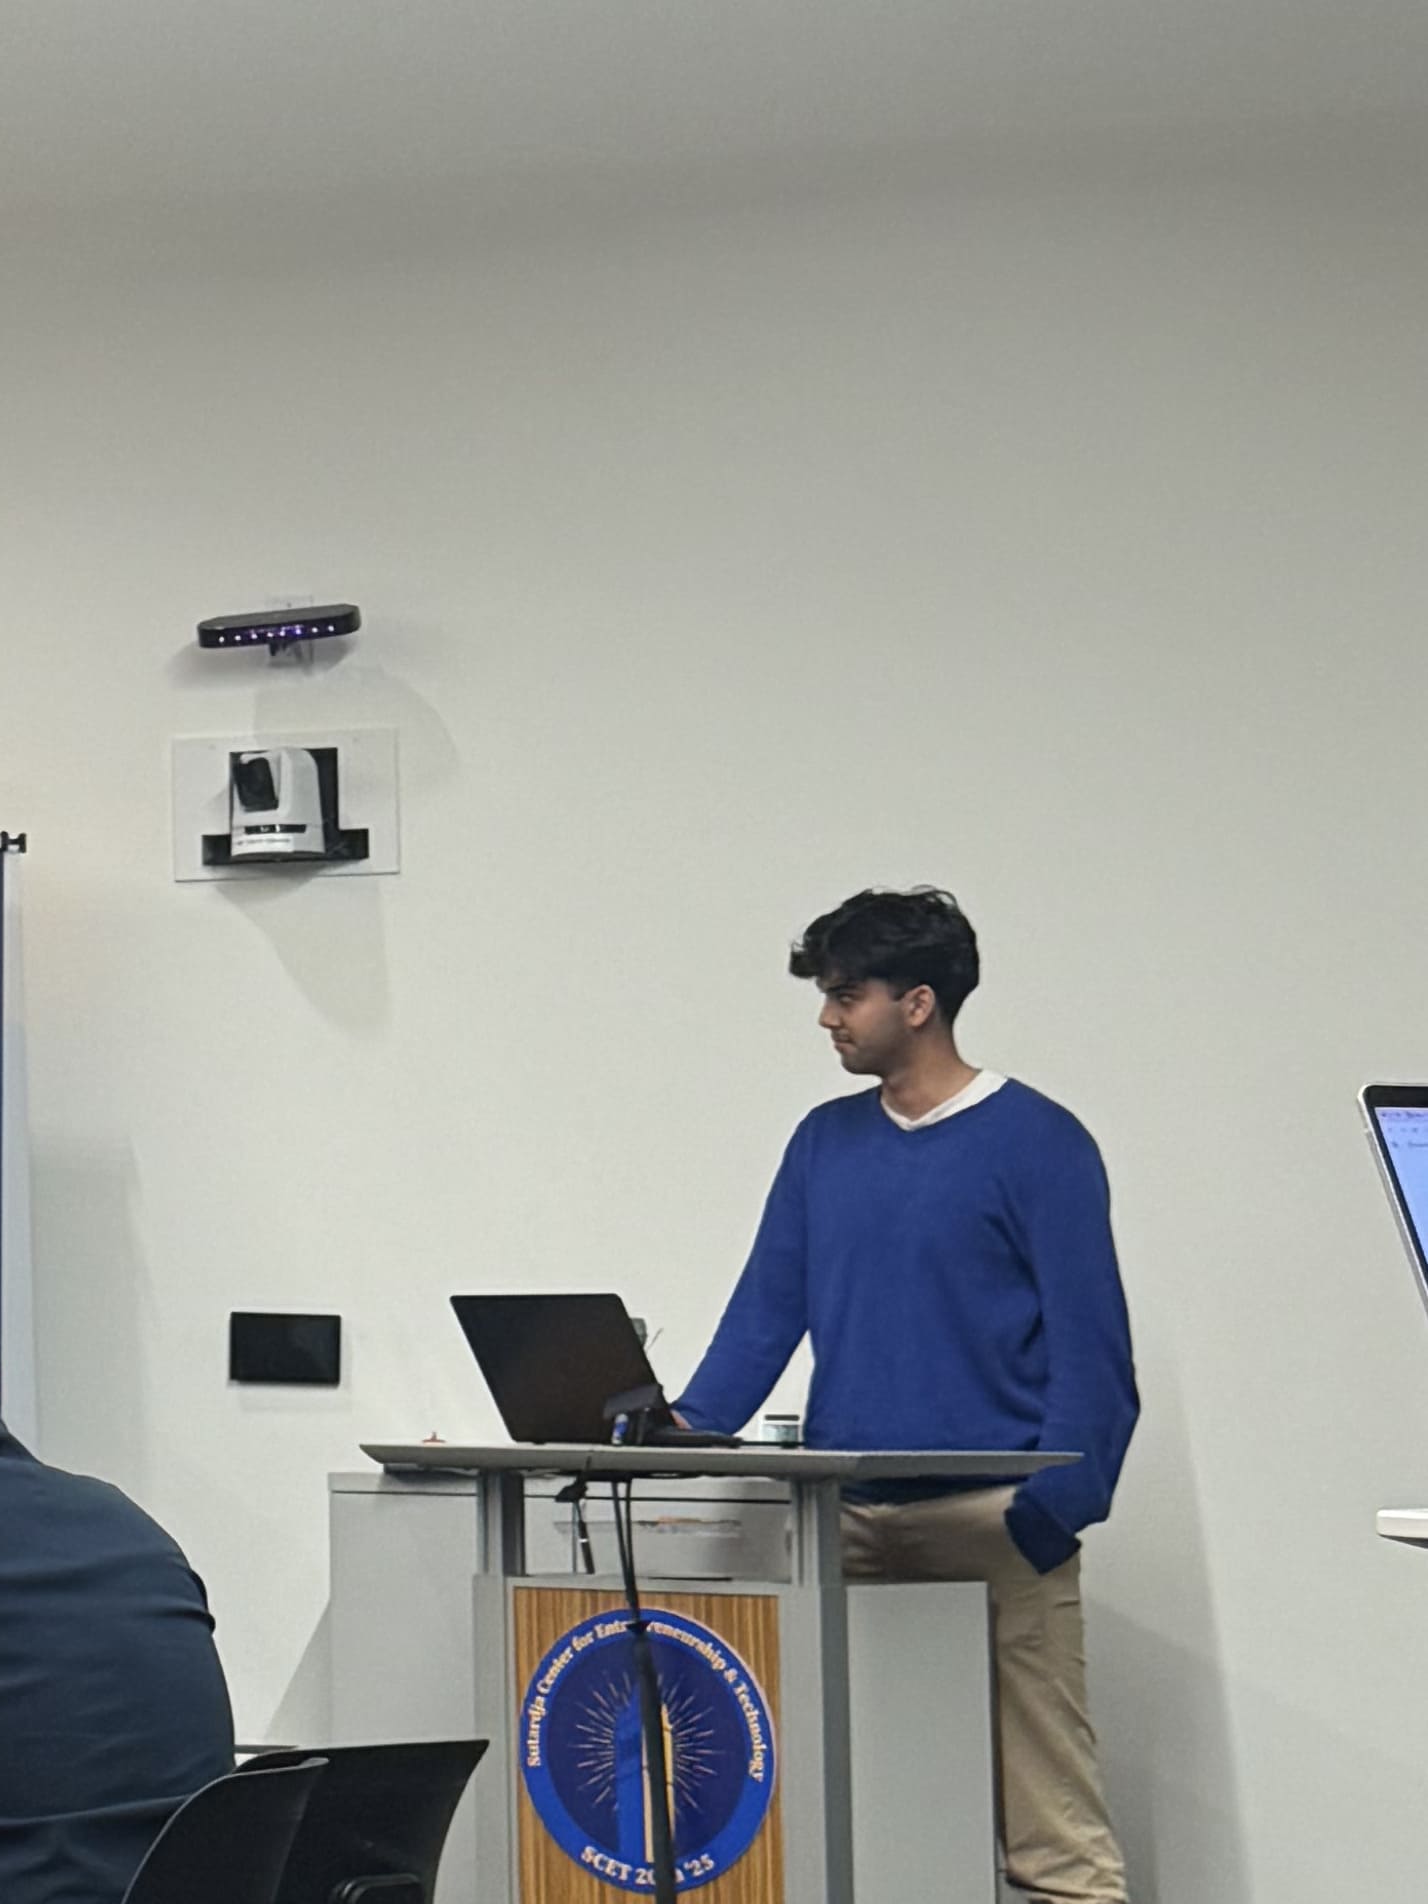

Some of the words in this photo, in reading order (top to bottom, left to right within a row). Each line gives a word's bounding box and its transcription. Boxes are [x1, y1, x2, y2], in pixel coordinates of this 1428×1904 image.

[535, 1645, 574, 1695] Center
[571, 1631, 595, 1652] for
[733, 1681, 767, 1783] Technology
[580, 1845, 633, 1881] SCET
